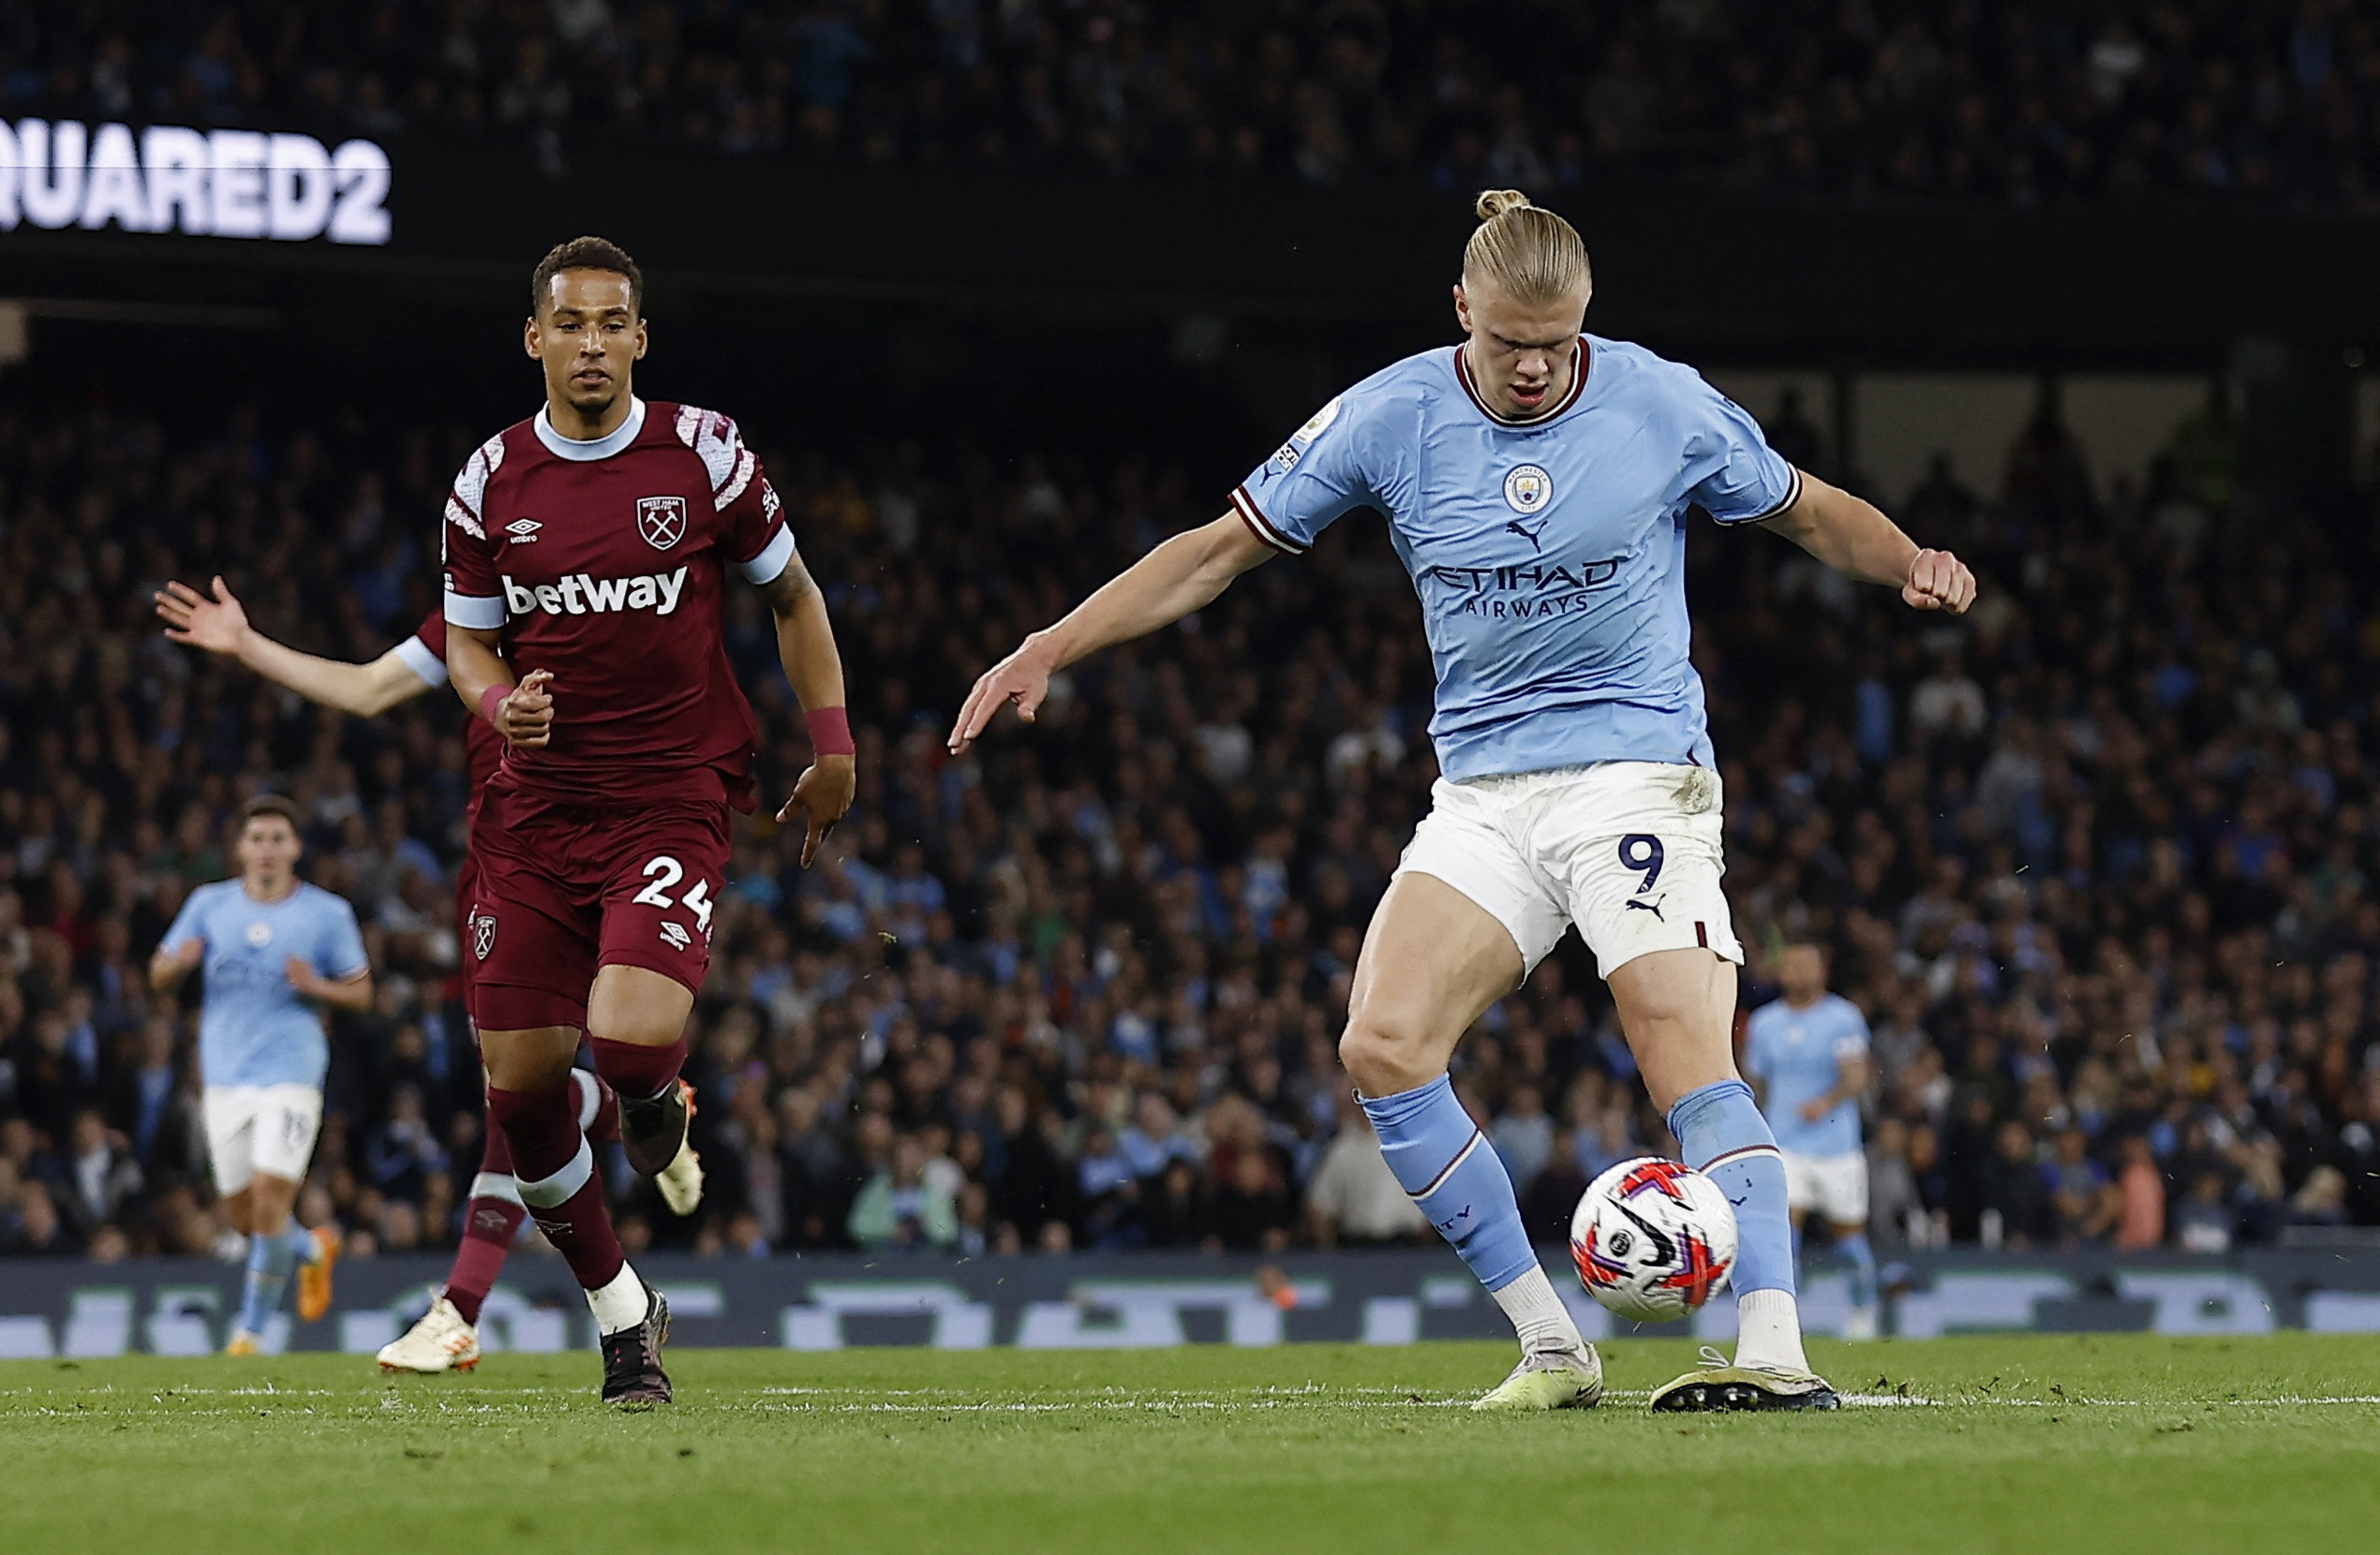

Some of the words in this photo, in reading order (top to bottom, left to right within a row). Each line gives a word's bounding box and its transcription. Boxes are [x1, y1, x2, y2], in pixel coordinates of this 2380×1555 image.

[0, 116, 393, 246] UARED2
[1508, 467, 1548, 484] MANCHESTER
[642, 499, 662, 509] WEST
[662, 498, 680, 507] HAM
[510, 535, 538, 543] umbro
[501, 566, 688, 615] betway
[1432, 558, 1618, 592] ETIHAD
[1465, 595, 1588, 618] AIRWAYS
[1618, 834, 1664, 895] 9
[632, 855, 713, 933] 24
